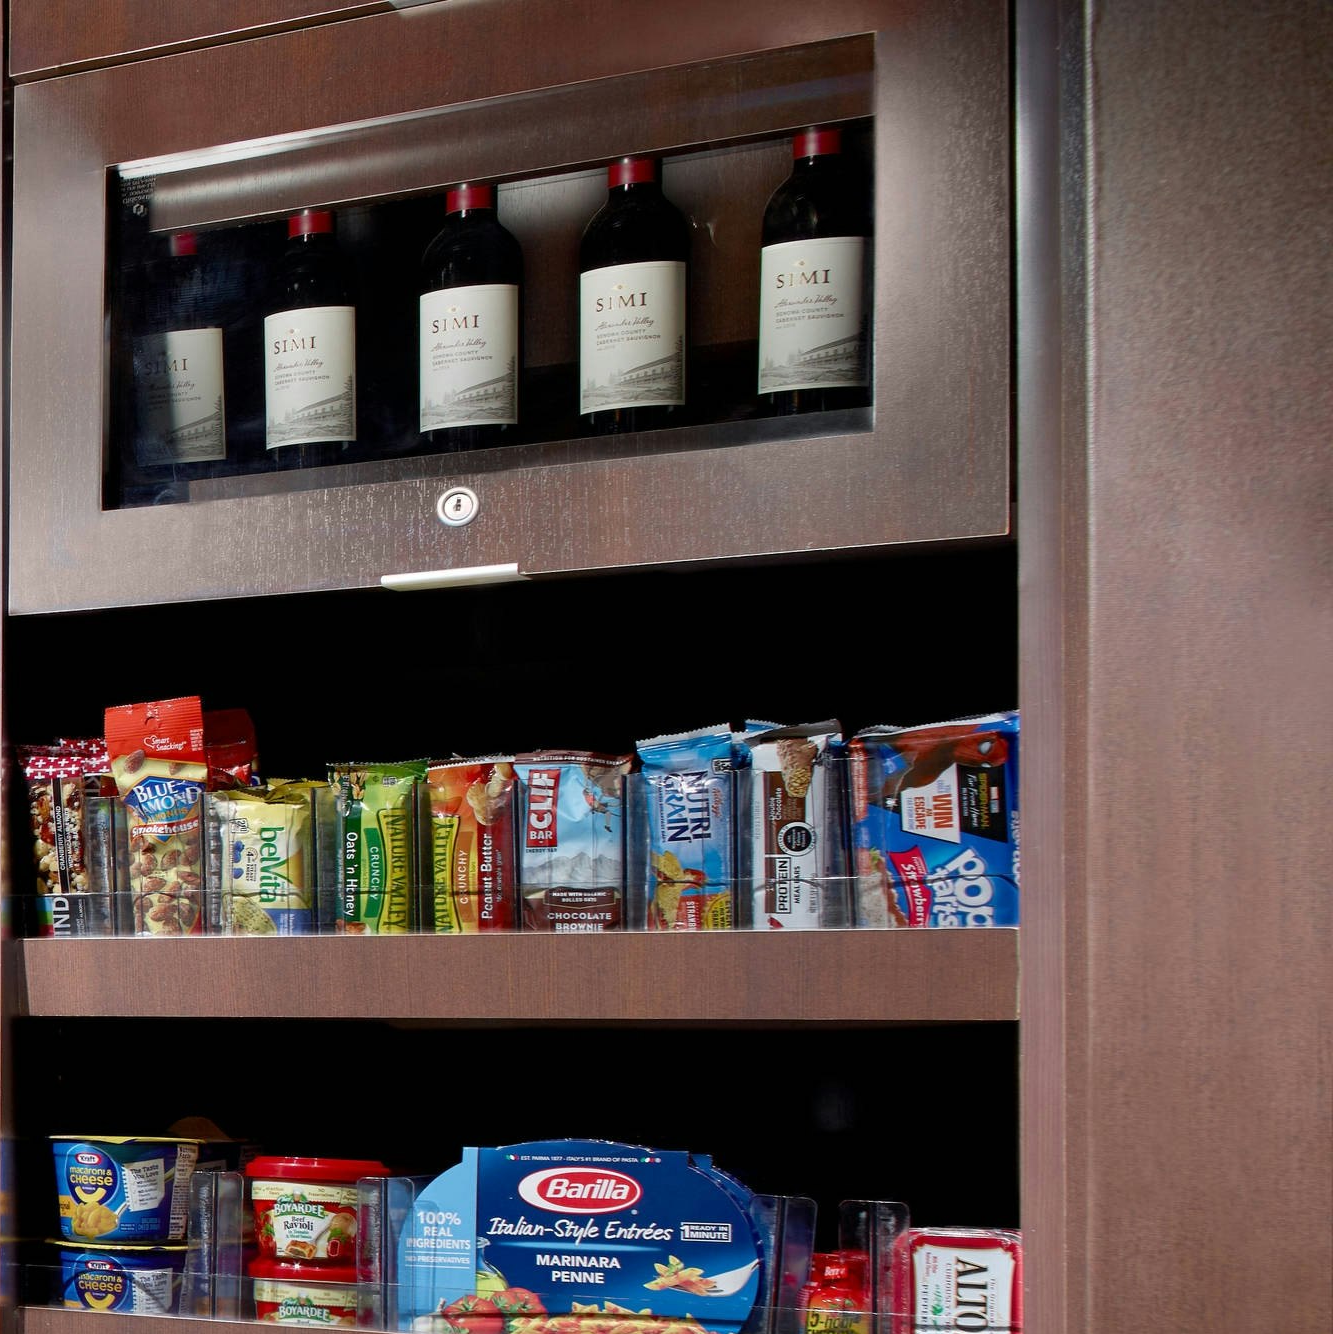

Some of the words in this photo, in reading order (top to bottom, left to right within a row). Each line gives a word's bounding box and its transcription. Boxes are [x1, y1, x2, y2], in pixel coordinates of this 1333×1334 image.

[776, 269, 831, 289] SIMI
[596, 292, 648, 313] SIMI
[432, 314, 480, 334] SIMI
[274, 336, 316, 354] SIMI
[134, 780, 177, 803] BLUE
[530, 772, 556, 830] CLIF
[775, 787, 783, 821] Chocolate
[915, 796, 926, 830] ESCAPE
[932, 793, 954, 829] WIN
[55, 806, 63, 833] ALMOND
[132, 820, 199, 837] Smokehouse
[346, 832, 359, 856] Oats
[530, 831, 553, 840] BAR
[58, 833, 66, 870] CRANBERRY
[481, 833, 494, 874] Butter
[369, 846, 381, 900] CRUNCHY
[459, 849, 469, 905] CRUNCHY
[778, 860, 789, 911] PROTEIN
[343, 878, 359, 917] Honey
[481, 875, 494, 921] Peanut
[70, 1167, 105, 1176] macaroni
[546, 1179, 630, 1200] Barilla
[274, 1202, 324, 1216] BOYARDEE
[417, 1212, 461, 1225] 100%
[283, 1221, 313, 1231] Ravioli
[424, 1227, 453, 1237] REAL
[487, 1216, 599, 1246] Italian-Style
[604, 1220, 673, 1241] Entrées
[690, 1231, 728, 1240] MINUTE
[406, 1237, 471, 1249] INGREDIENTS
[417, 1256, 470, 1264] PRESERVATIVES
[536, 1254, 621, 1269] MARINARA
[551, 1271, 605, 1284] PENNE
[279, 1305, 329, 1320] BOYARDEE
